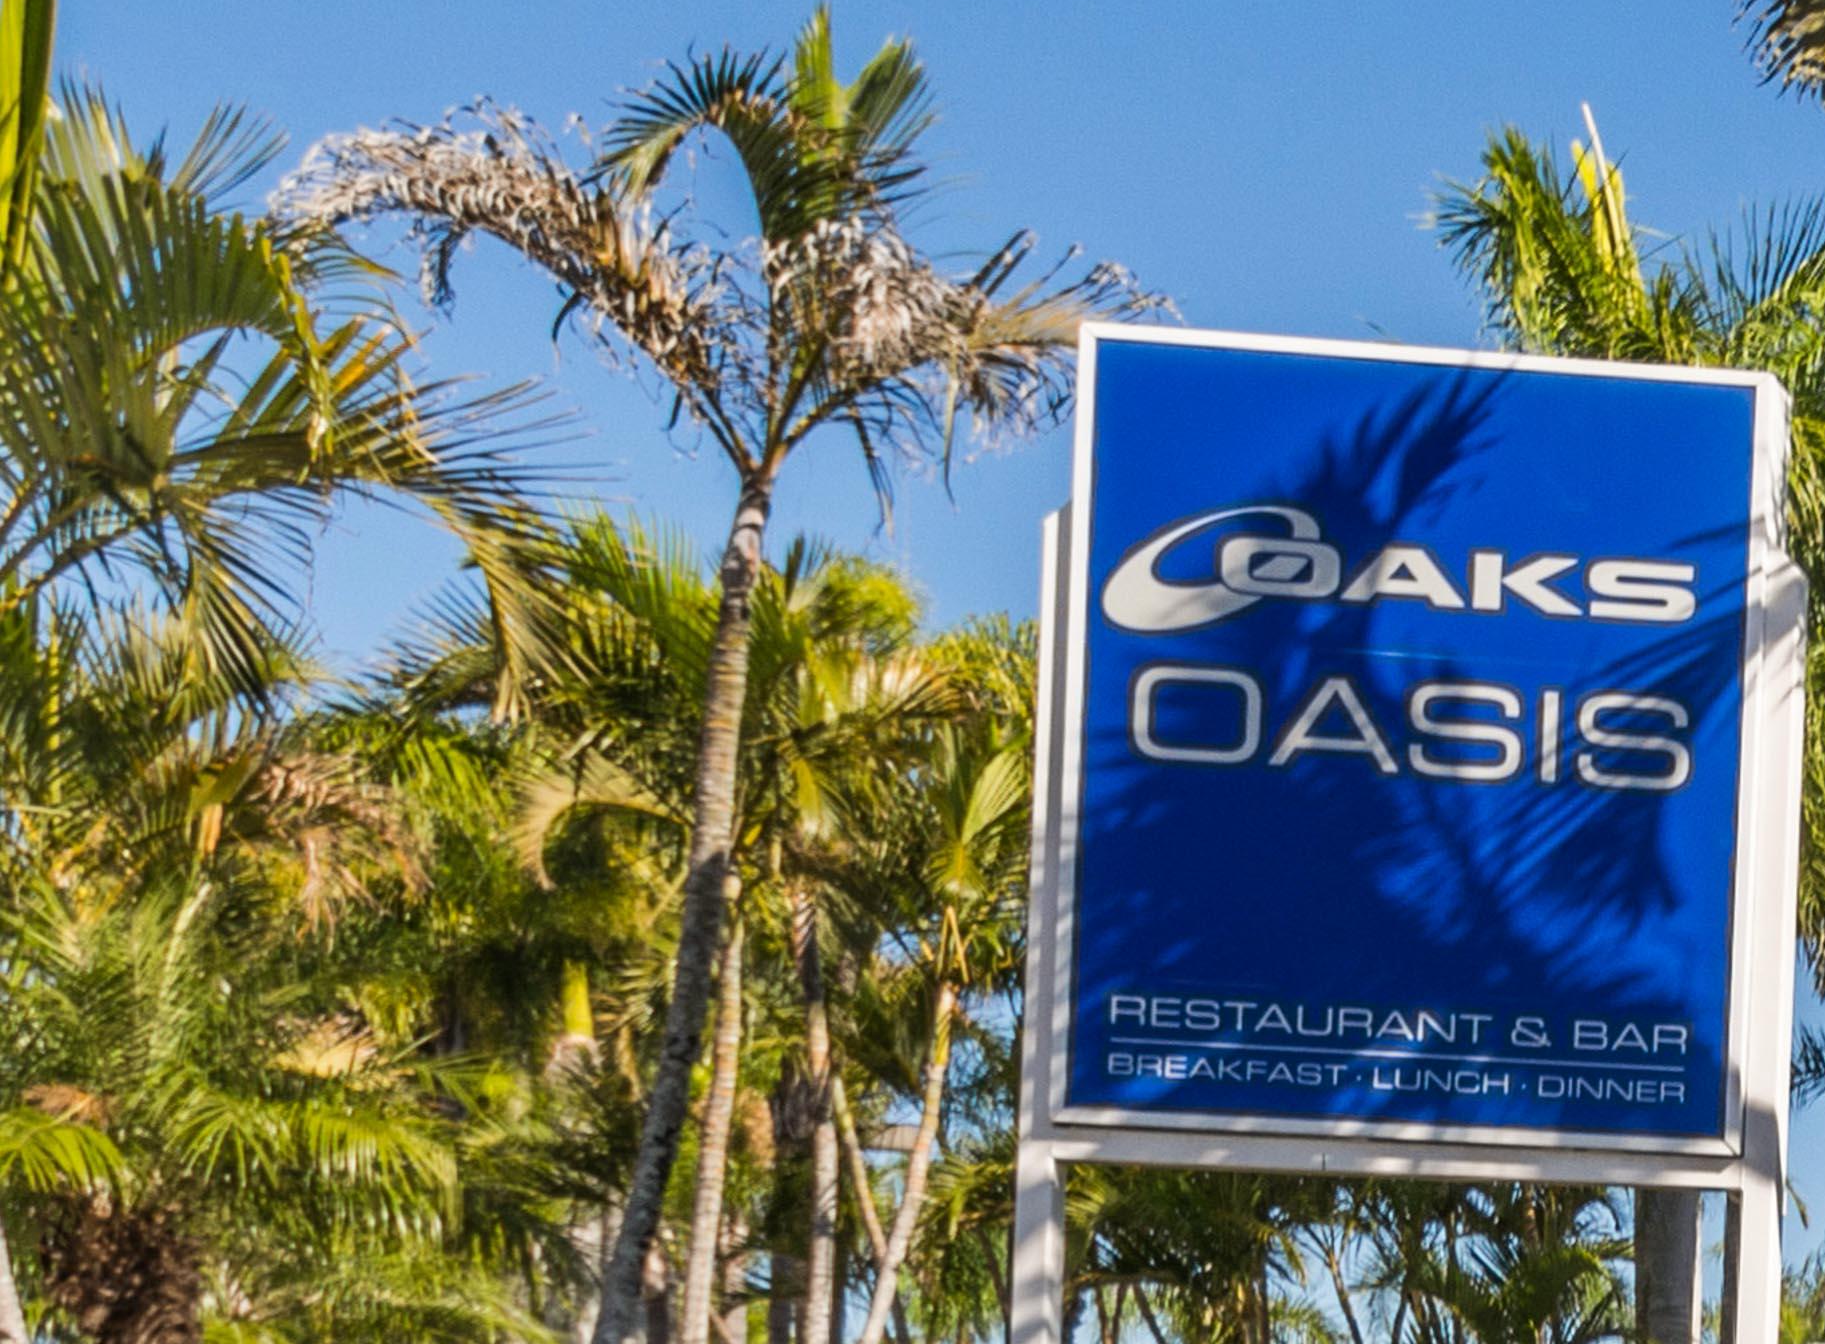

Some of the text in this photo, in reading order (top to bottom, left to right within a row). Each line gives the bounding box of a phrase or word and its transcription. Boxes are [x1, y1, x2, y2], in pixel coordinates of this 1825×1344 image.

[1217, 530, 1698, 624] OAKS
[1131, 665, 1691, 790] OASIS
[1109, 994, 1689, 1055] RESTAURANT & BAR
[1107, 1054, 1686, 1104] BREAKFAST LUNCH DINNER
